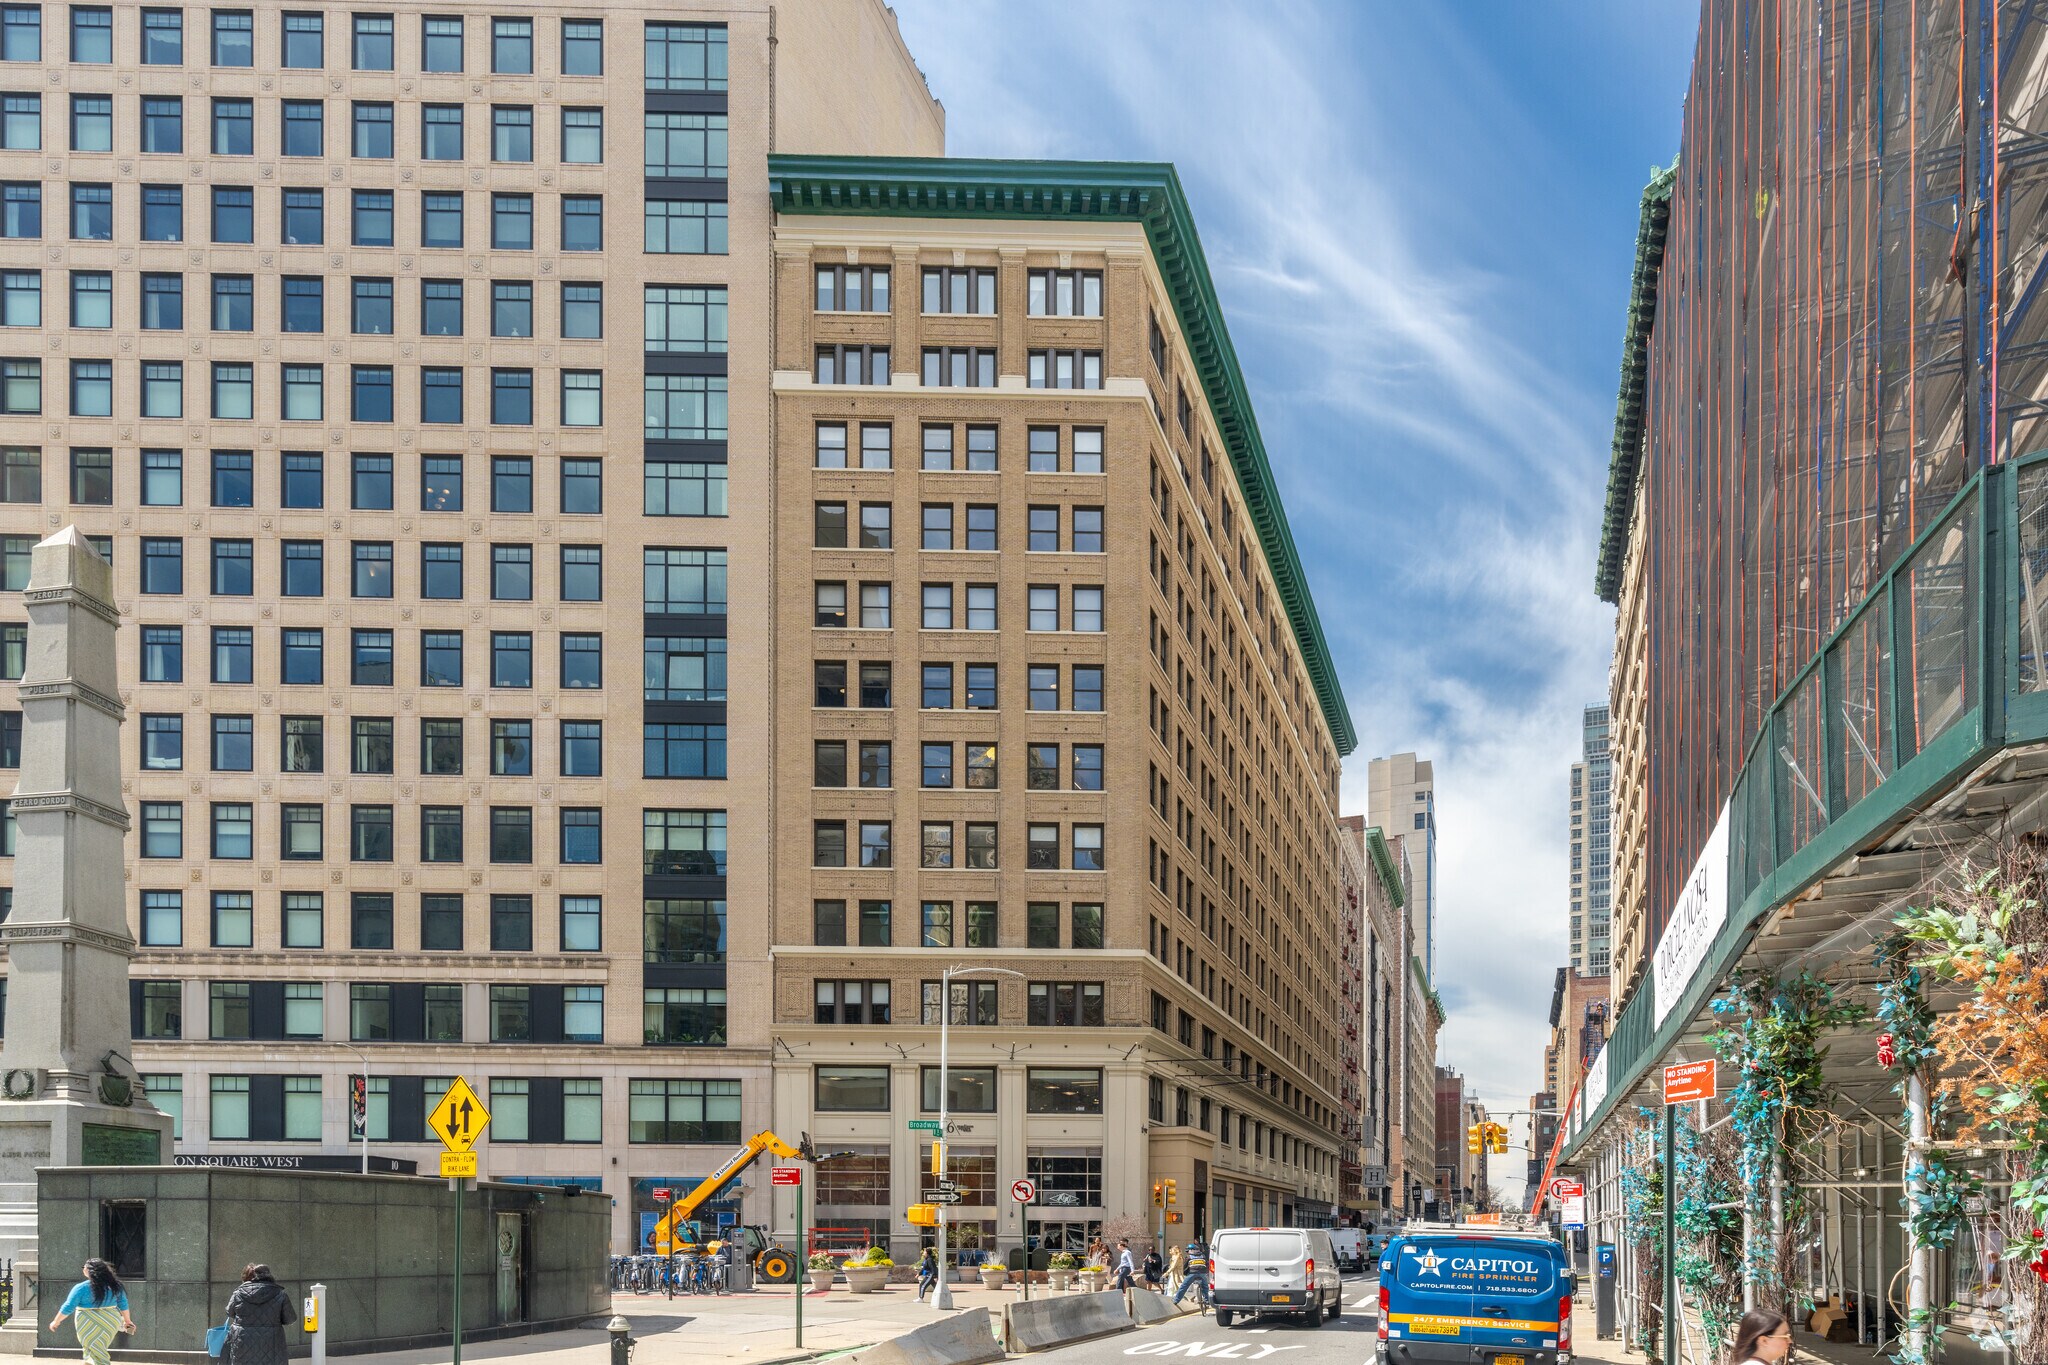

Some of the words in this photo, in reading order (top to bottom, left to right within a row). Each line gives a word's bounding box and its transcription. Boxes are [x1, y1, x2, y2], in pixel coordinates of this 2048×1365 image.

[32, 590, 62, 599] PEROTE
[28, 684, 60, 694] PUEBLA
[13, 798, 39, 807] CERRO
[40, 797, 66, 805] GORDO
[8, 927, 61, 937] CHAPULTEPEC
[1667, 1070, 1676, 1078] NO
[1677, 1065, 1707, 1077] STANDING
[1667, 1077, 1692, 1087] Anytime
[909, 1121, 939, 1129] Broadway
[200, 1156, 259, 1167] SQUARE
[261, 1156, 303, 1167] WEST
[719, 1160, 734, 1174] United
[733, 1147, 749, 1163] Rentals
[1369, 1172, 1379, 1181] H
[1603, 1253, 1609, 1262] P
[1451, 1257, 1539, 1274] CAPITOL
[1479, 1273, 1537, 1282] SPRINKLER
[1410, 1282, 1473, 1290] CAPITOLFIRE.COM
[1486, 1286, 1538, 1294] 718.533.6800
[1436, 1318, 1489, 1327] EMERGENCY
[1492, 1320, 1531, 1329] SERVICE
[1123, 1341, 1308, 1359] ONLY
